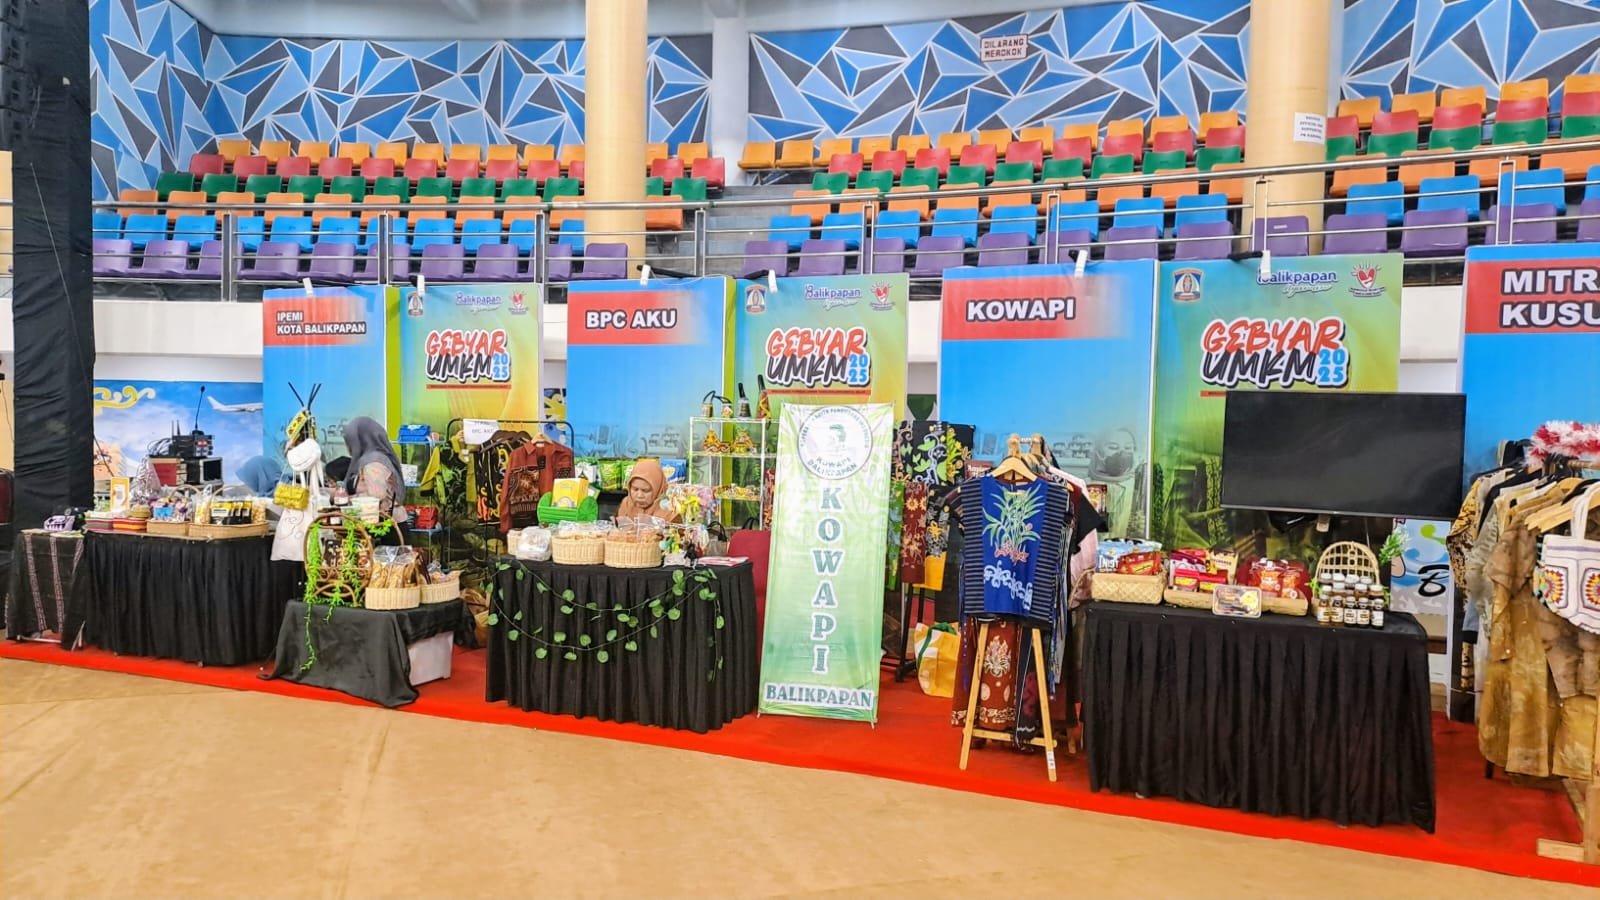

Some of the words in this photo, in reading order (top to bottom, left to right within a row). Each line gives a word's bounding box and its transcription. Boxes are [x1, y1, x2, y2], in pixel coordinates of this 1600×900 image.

[984, 38, 1024, 49] DILARANG
[984, 48, 1022, 58] MEROKOK
[806, 284, 861, 298] Balikpapan
[1502, 268, 1600, 294] MITR
[276, 311, 304, 323] IPEMI
[585, 310, 627, 329] BPC
[631, 308, 677, 328] AKU
[966, 298, 1076, 321] KOWAPI
[276, 323, 303, 335] KOTA
[304, 323, 367, 335] BALIKPAPAN
[1203, 319, 1342, 354] GEBYAR
[426, 330, 506, 358] GEBYAR
[767, 328, 867, 358] GEBYAR
[426, 353, 492, 381] UMKM
[767, 353, 847, 384] UMKM
[1203, 349, 1317, 384] UMKM
[812, 487, 843, 672] KOWAPI
[765, 684, 873, 708] BALIKPAPAN
